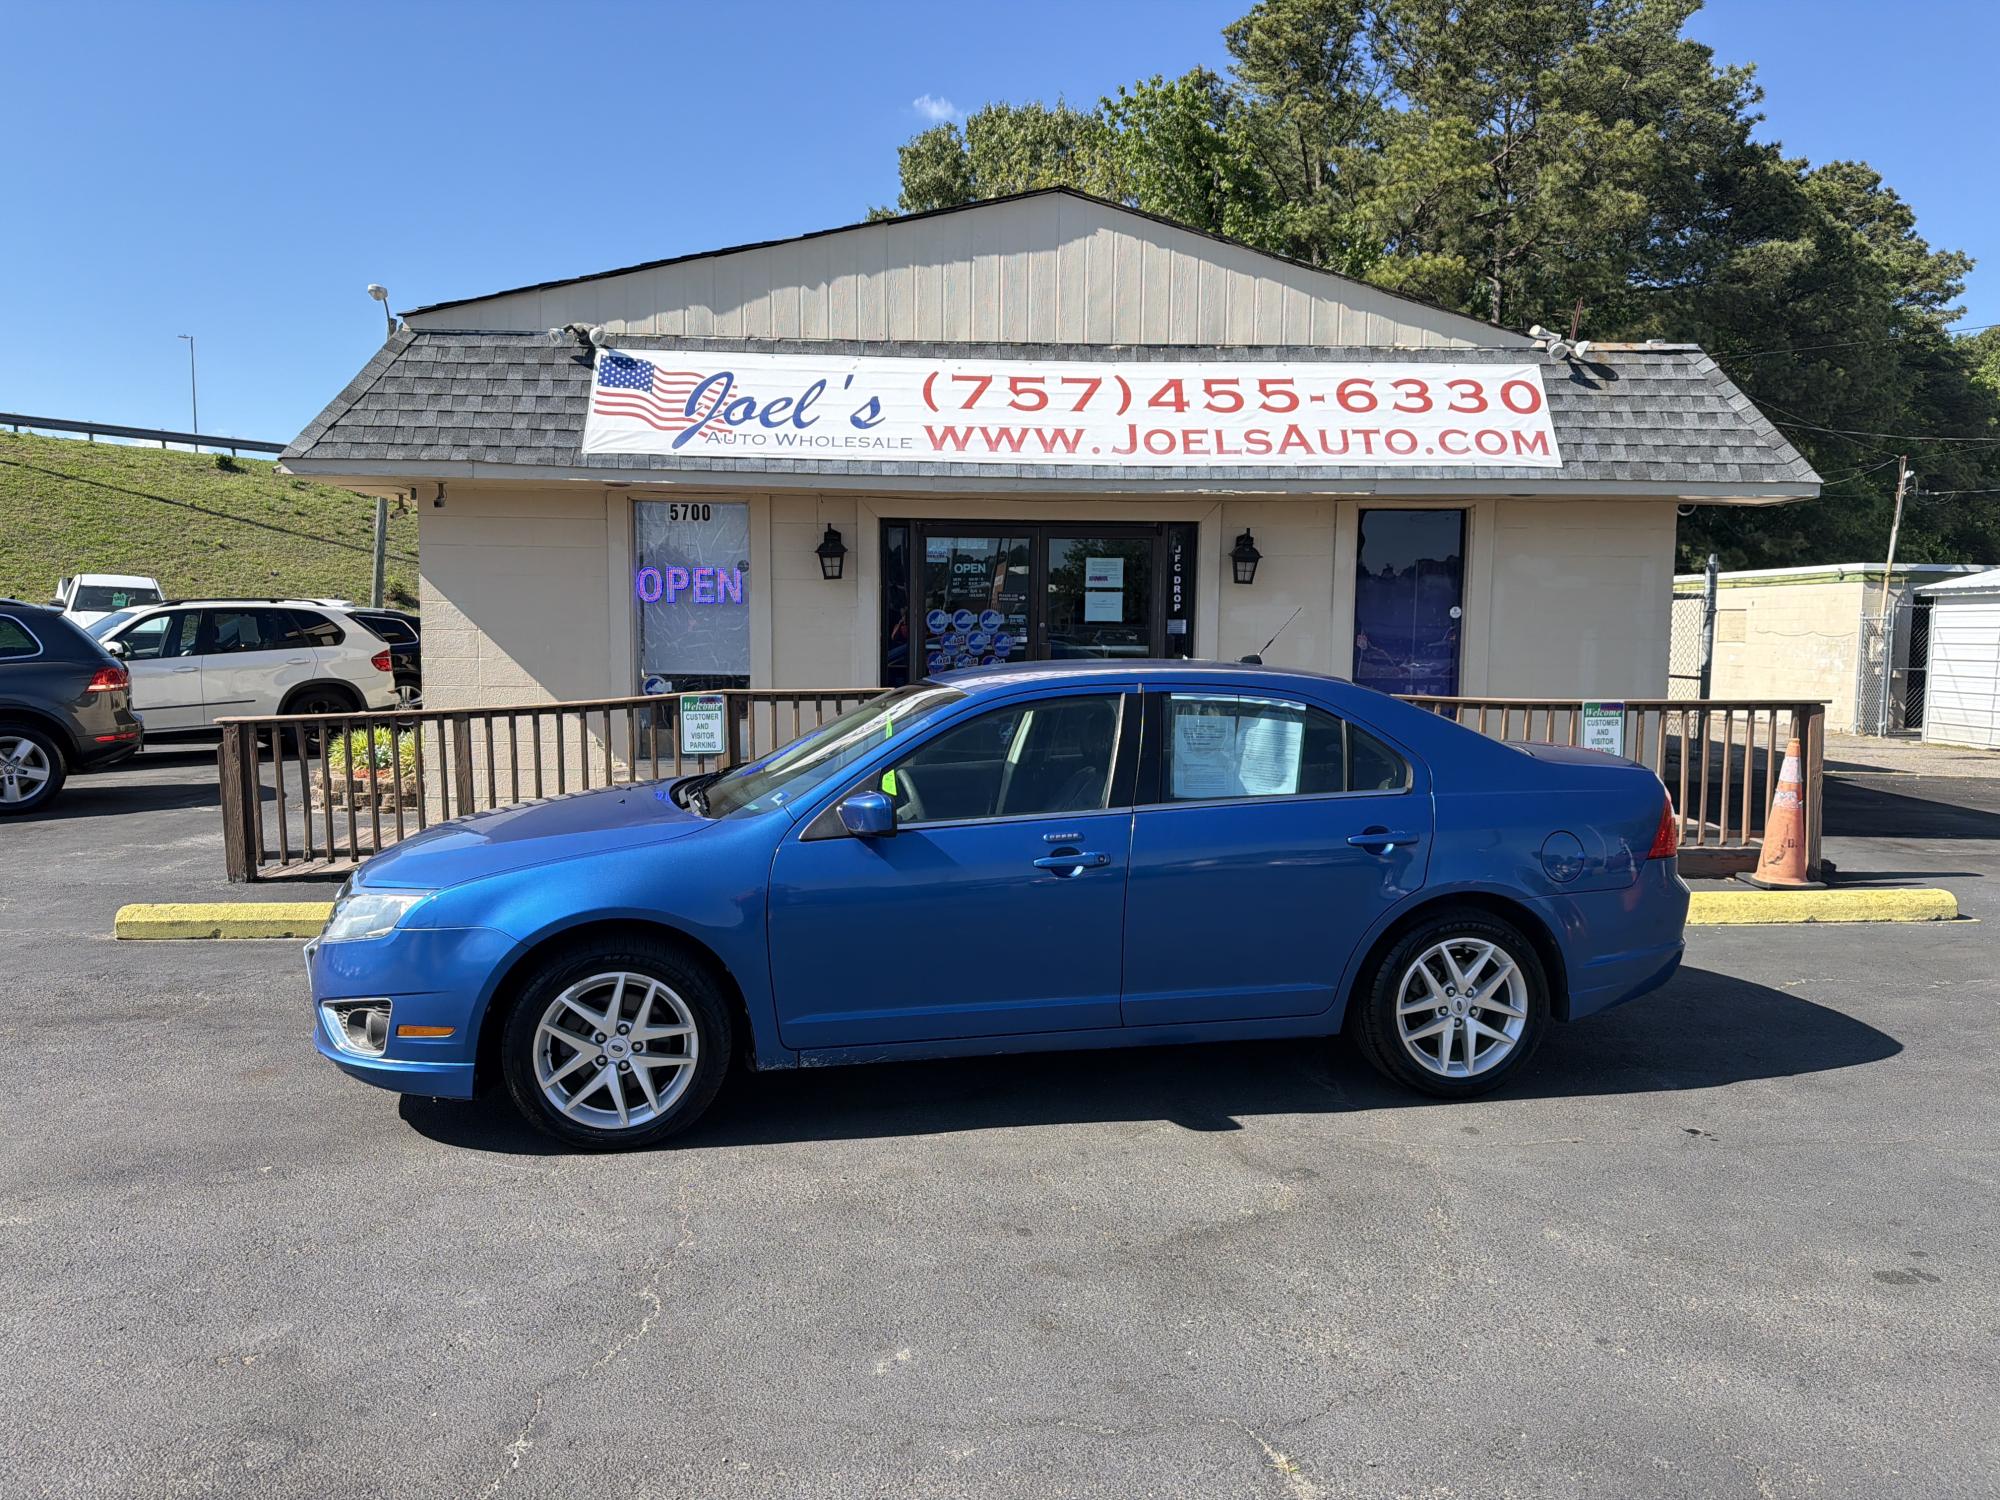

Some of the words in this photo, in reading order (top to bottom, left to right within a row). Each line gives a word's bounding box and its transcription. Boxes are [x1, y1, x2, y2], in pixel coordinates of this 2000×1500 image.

[672, 371, 886, 449] Joel's
[705, 431, 767, 446] AUTO
[775, 433, 913, 449] WHOLESALE
[669, 503, 711, 521] 5700
[954, 563, 986, 574] OPEN
[636, 566, 743, 604] OPEN
[1173, 575, 1182, 612] DROP
[684, 702, 721, 711] Welcome
[686, 713, 719, 721] CUSTOMER
[1585, 708, 1621, 717] Welcome
[696, 722, 709, 730] AND
[1587, 719, 1619, 727] CUSTOMER
[691, 732, 715, 740] VISITOR
[1597, 728, 1609, 736] AND
[690, 741, 716, 749] PARKING
[1591, 737, 1614, 745] VISITOR
